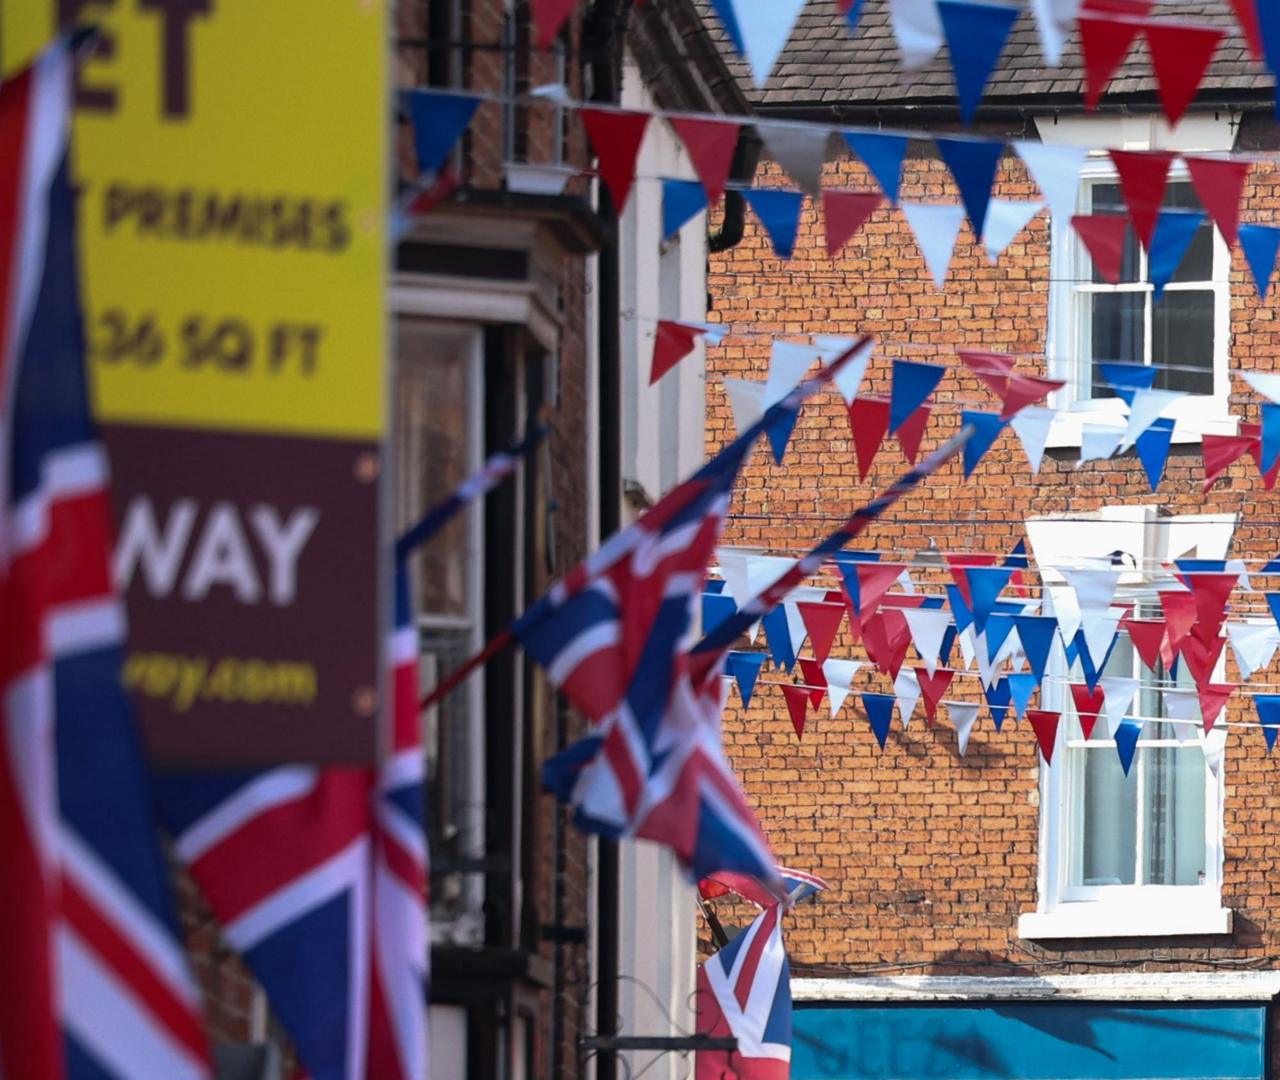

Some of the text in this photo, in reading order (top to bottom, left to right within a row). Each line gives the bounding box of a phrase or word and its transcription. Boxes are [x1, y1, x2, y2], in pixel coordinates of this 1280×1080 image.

[105, 182, 352, 256] PREMISES
[180, 314, 254, 374] SQ
[270, 320, 325, 378] FT
